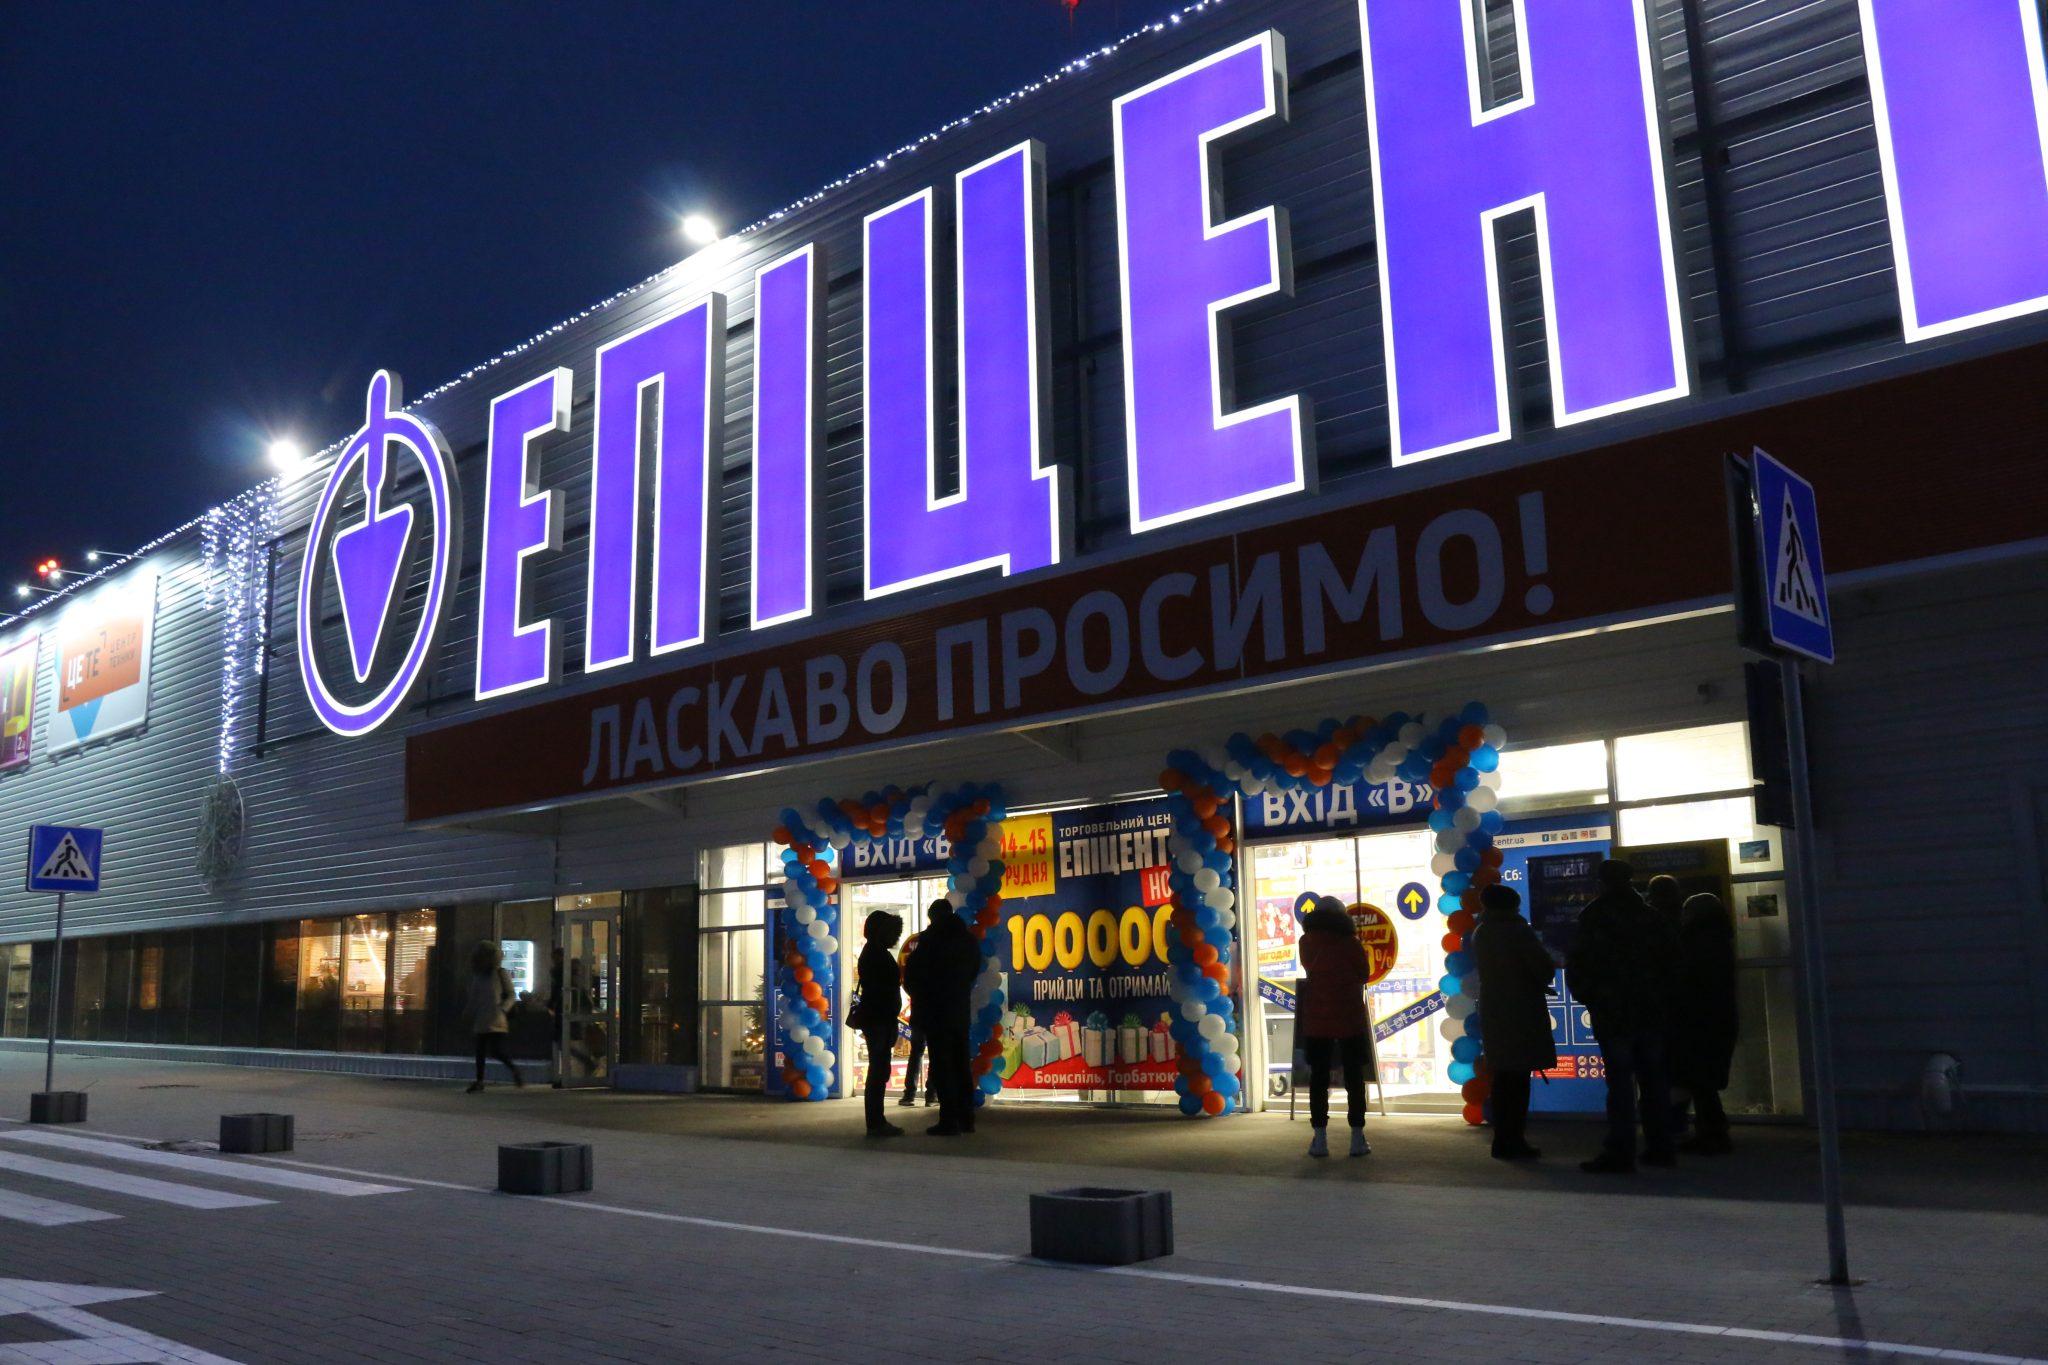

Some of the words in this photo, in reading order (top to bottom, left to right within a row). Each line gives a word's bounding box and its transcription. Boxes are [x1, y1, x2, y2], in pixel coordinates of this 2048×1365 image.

[474, 0, 2048, 702] ЕПІЦЕН
[581, 639, 908, 785] ЛАСКАВО
[935, 491, 1556, 722] ПРОСИМО!
[1263, 783, 1358, 827] ВХІД
[1367, 776, 1434, 814] «В»
[1059, 815, 1144, 838] ТОРГОВЕЛЬНИЙ
[1147, 813, 1171, 827] ЦЕН
[854, 837, 917, 869] ВХІД
[1059, 828, 1170, 878] ЕПІЦЕНТ
[1004, 860, 1048, 887] РУДНЯ
[1033, 976, 1084, 1002] ПРИЙДИ
[1088, 977, 1104, 1000] ТА
[1109, 973, 1171, 999] ОТРИМАЙ
[1034, 1069, 1105, 1086] Бориспіль,
[1108, 1068, 1180, 1086] Горбатюк
